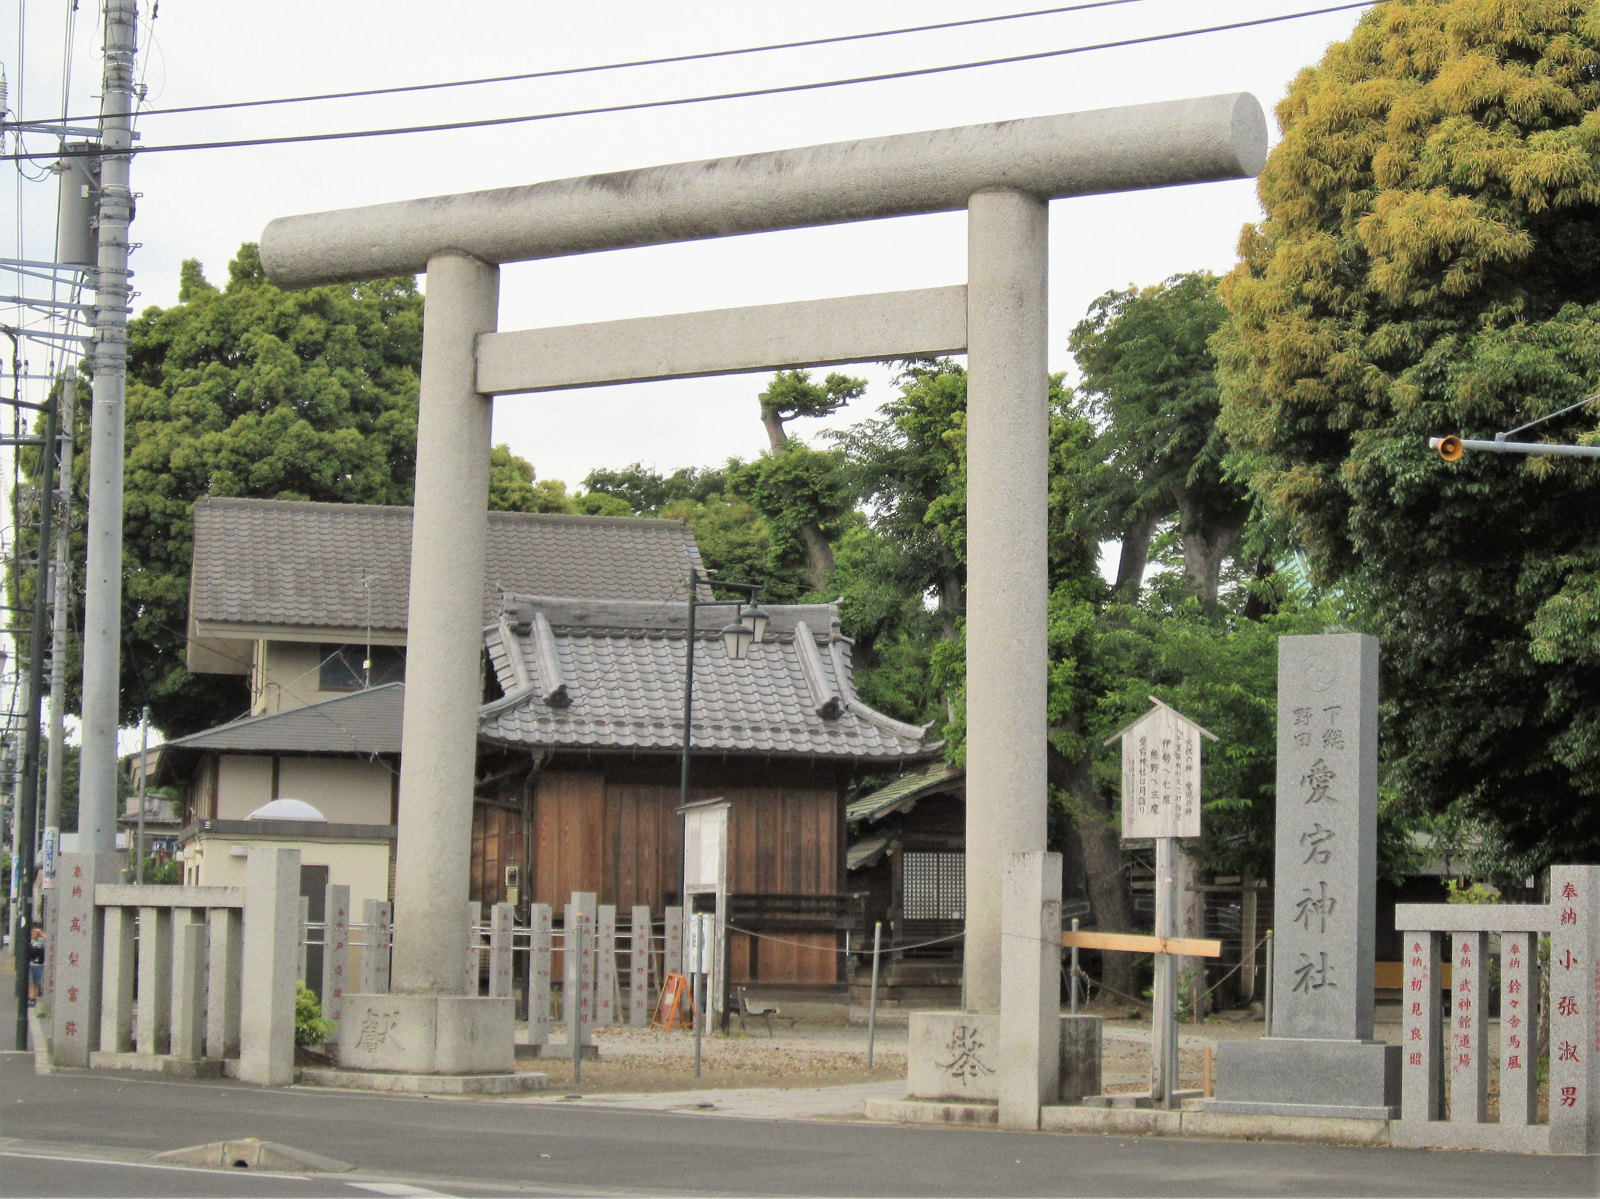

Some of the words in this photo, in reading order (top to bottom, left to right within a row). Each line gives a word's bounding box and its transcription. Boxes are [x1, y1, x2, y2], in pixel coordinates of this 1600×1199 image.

[1292, 706, 1313, 748] 野田
[1138, 736, 1147, 814] 愛宕神社は月詣り
[1150, 749, 1159, 815] 熊野へ三度
[1162, 739, 1171, 805] 伊勢へ七度
[72, 865, 83, 899] 奉納
[1292, 758, 1339, 996] 愛宕神社
[1561, 883, 1579, 925] 奉納
[1412, 942, 1423, 967] 奉納
[1460, 943, 1472, 967] 奉納
[1509, 943, 1522, 969] 奉納
[1410, 977, 1423, 1066] 初見良昭
[1459, 979, 1472, 1068] 武神館道場
[1508, 979, 1522, 1070] 鈴々舎馬風
[1558, 950, 1581, 1108] 小張淑男
